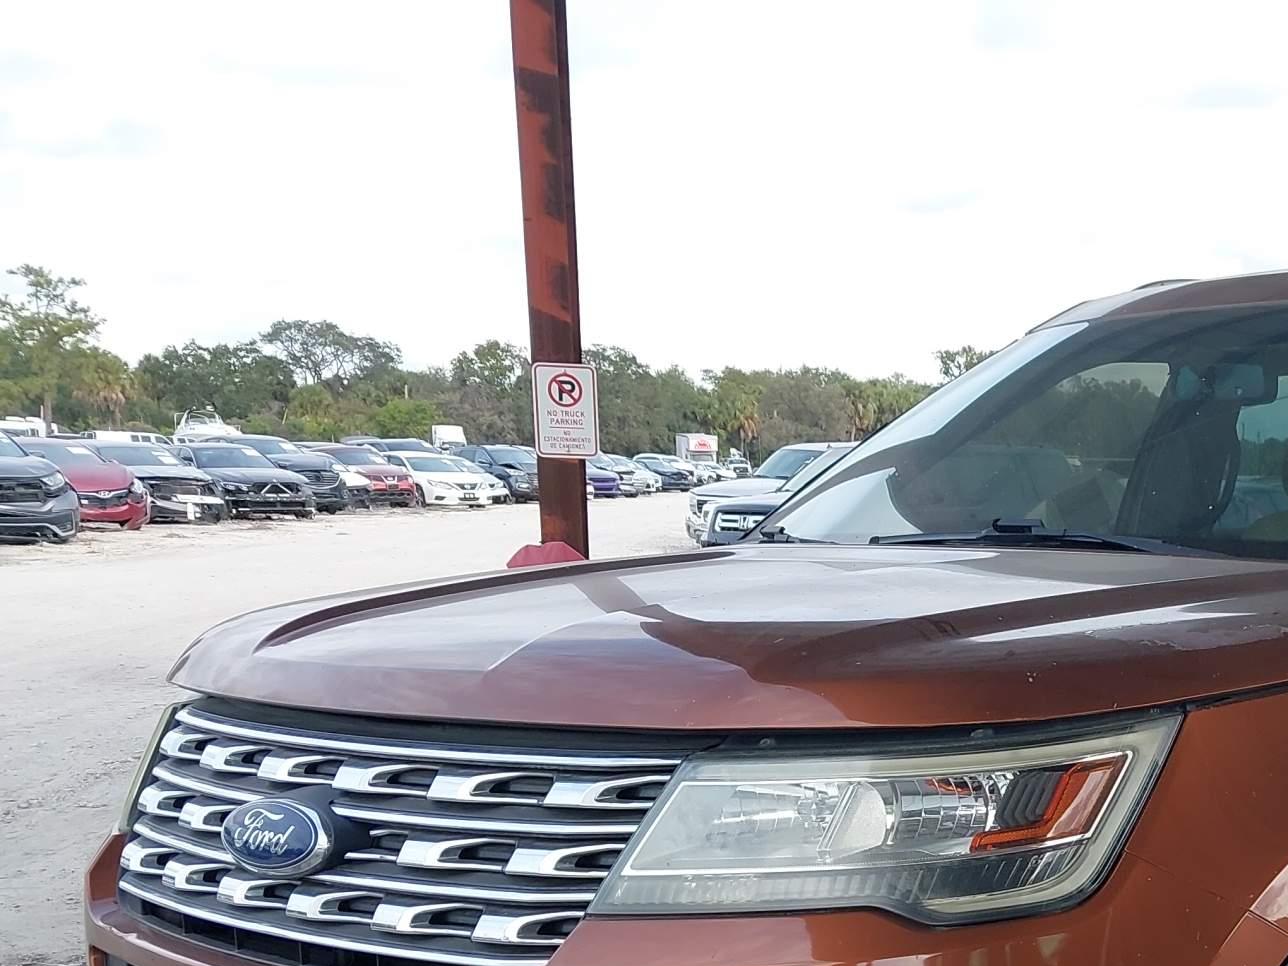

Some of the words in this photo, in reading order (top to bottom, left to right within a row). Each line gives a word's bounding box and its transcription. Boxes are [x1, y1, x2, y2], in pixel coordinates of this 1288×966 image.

[560, 410, 586, 418] TRUCK
[550, 418, 584, 426] PARKING
[234, 808, 295, 855] Ford
